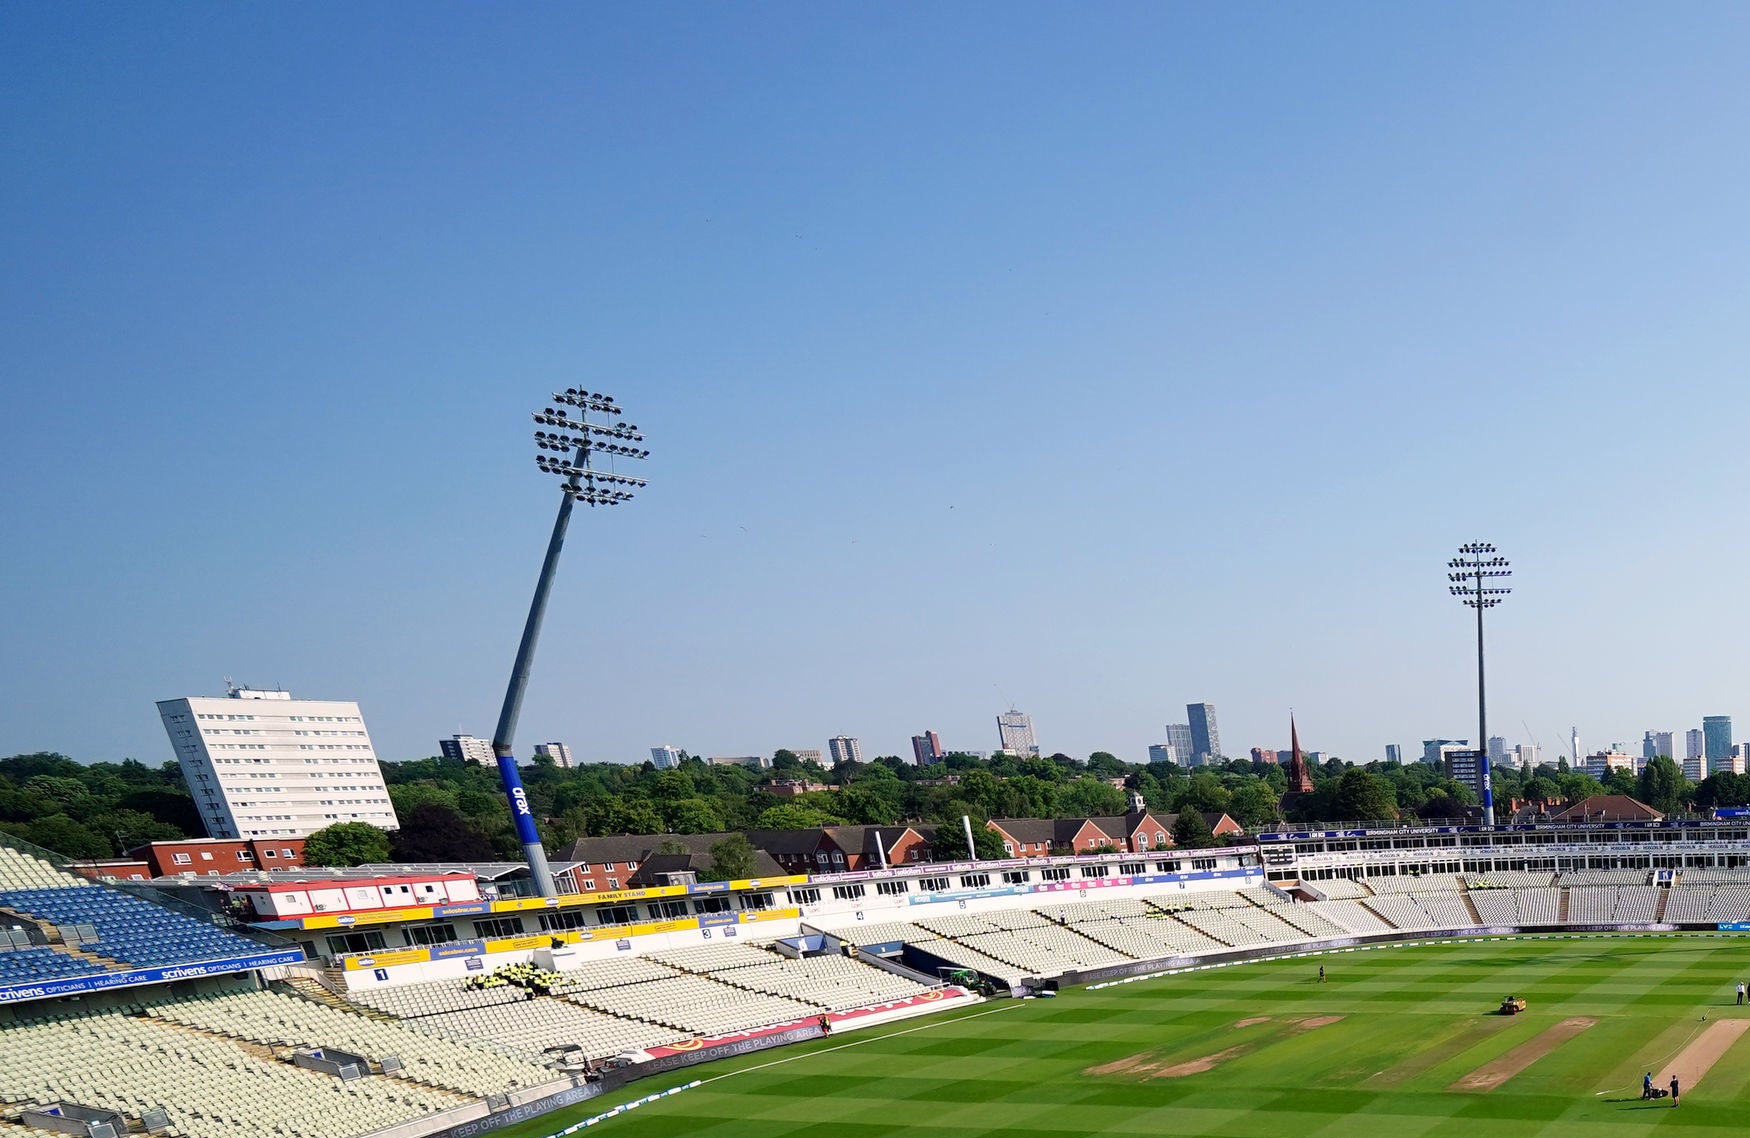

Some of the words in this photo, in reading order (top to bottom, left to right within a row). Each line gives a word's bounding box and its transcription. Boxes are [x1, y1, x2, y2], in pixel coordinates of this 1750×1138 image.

[512, 787, 531, 815] drax
[597, 892, 622, 900] FAMILY
[162, 966, 206, 979] scrivens
[208, 962, 241, 972] OPTICIANS
[249, 957, 277, 967] HEARING
[278, 955, 294, 963] CARE
[0, 986, 44, 1000] crivens
[46, 983, 86, 993] OPTICIANS
[94, 976, 128, 987] HEARING
[128, 974, 147, 983] CARE
[681, 1050, 707, 1063] KEEP
[709, 1044, 730, 1058] OFF
[733, 1039, 752, 1053] THE
[753, 1031, 794, 1049] PLAYING
[796, 1026, 821, 1041] AREA
[481, 1116, 501, 1131] OFF
[504, 1110, 523, 1124] THE
[524, 1095, 564, 1120] PLAYING
[566, 1087, 591, 1103] AREA
